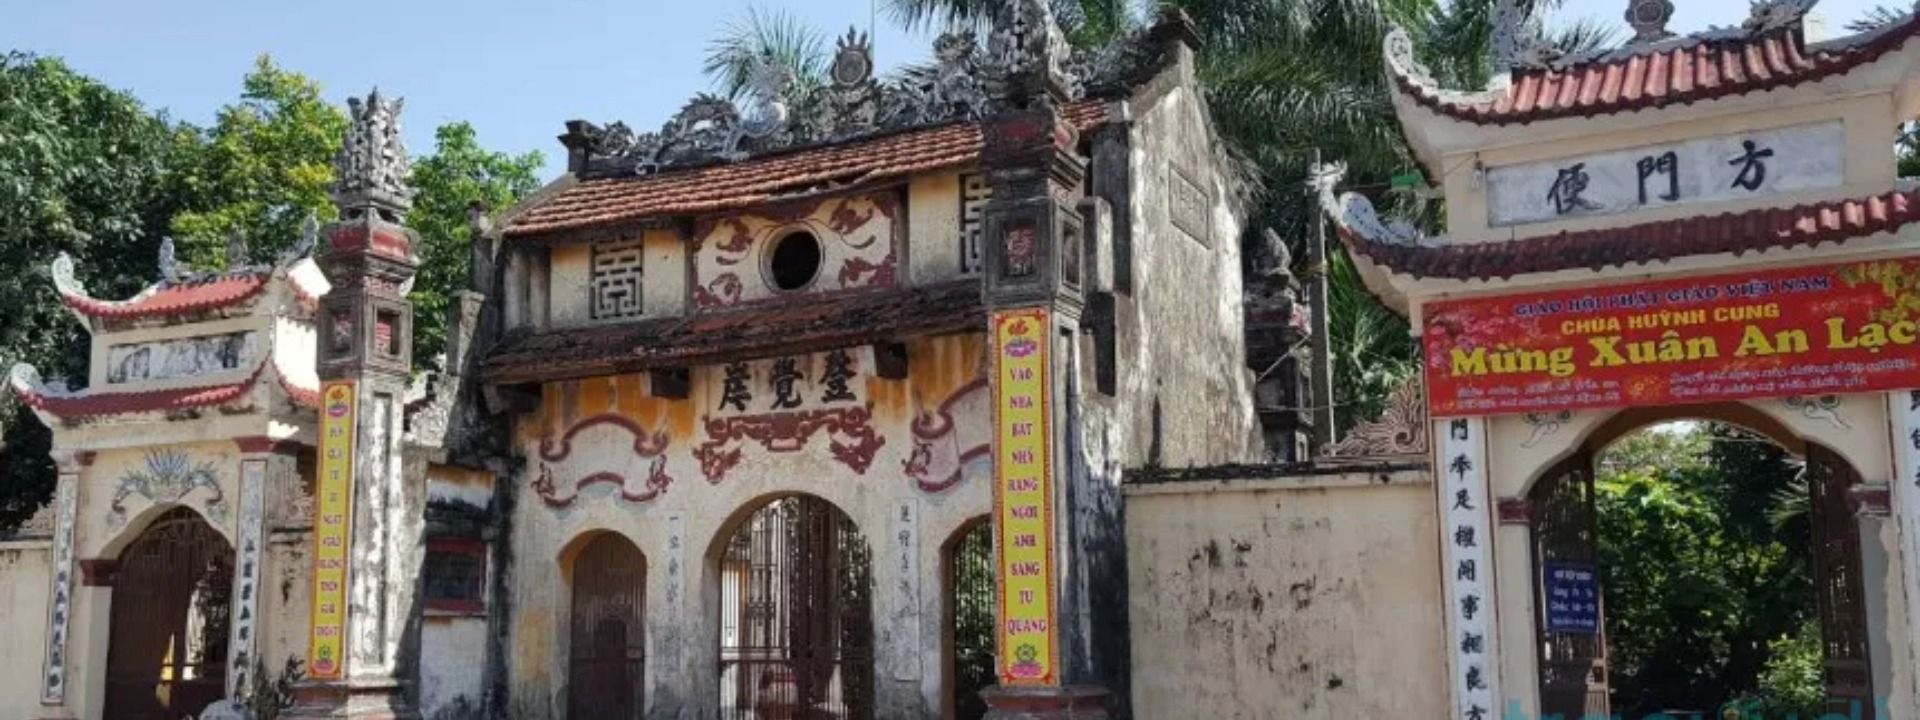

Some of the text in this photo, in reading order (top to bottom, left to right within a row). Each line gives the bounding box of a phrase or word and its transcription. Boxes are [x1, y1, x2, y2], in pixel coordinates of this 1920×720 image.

[1780, 276, 1829, 292] NAM
[1713, 303, 1780, 323] CUNG
[1450, 316, 1918, 377] Mừng Xuân An Lạc
